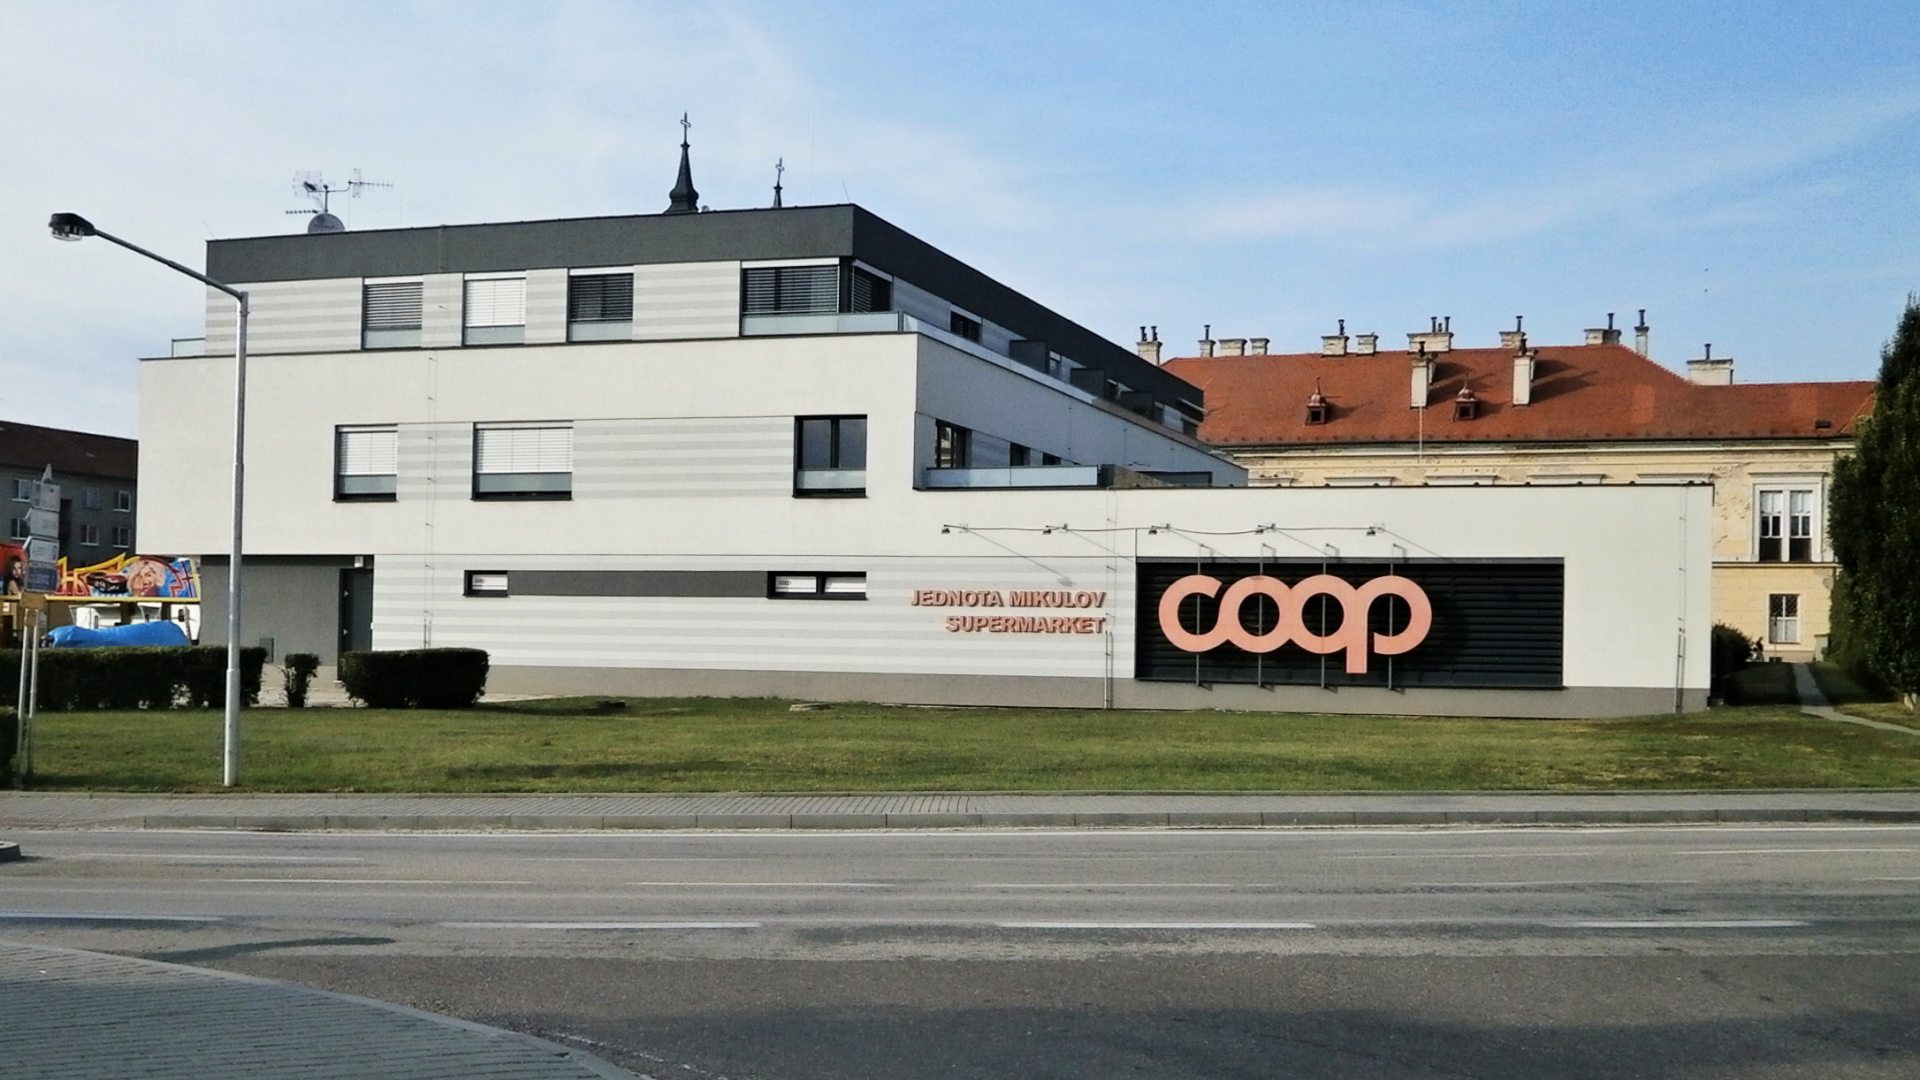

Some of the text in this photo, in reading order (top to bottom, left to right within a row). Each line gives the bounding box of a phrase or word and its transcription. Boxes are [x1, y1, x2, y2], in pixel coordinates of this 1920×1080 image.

[911, 589, 1107, 608] JEDNOTA MIKULOV
[945, 615, 1106, 634] SUPERMARKET
[1158, 574, 1432, 674] coop
